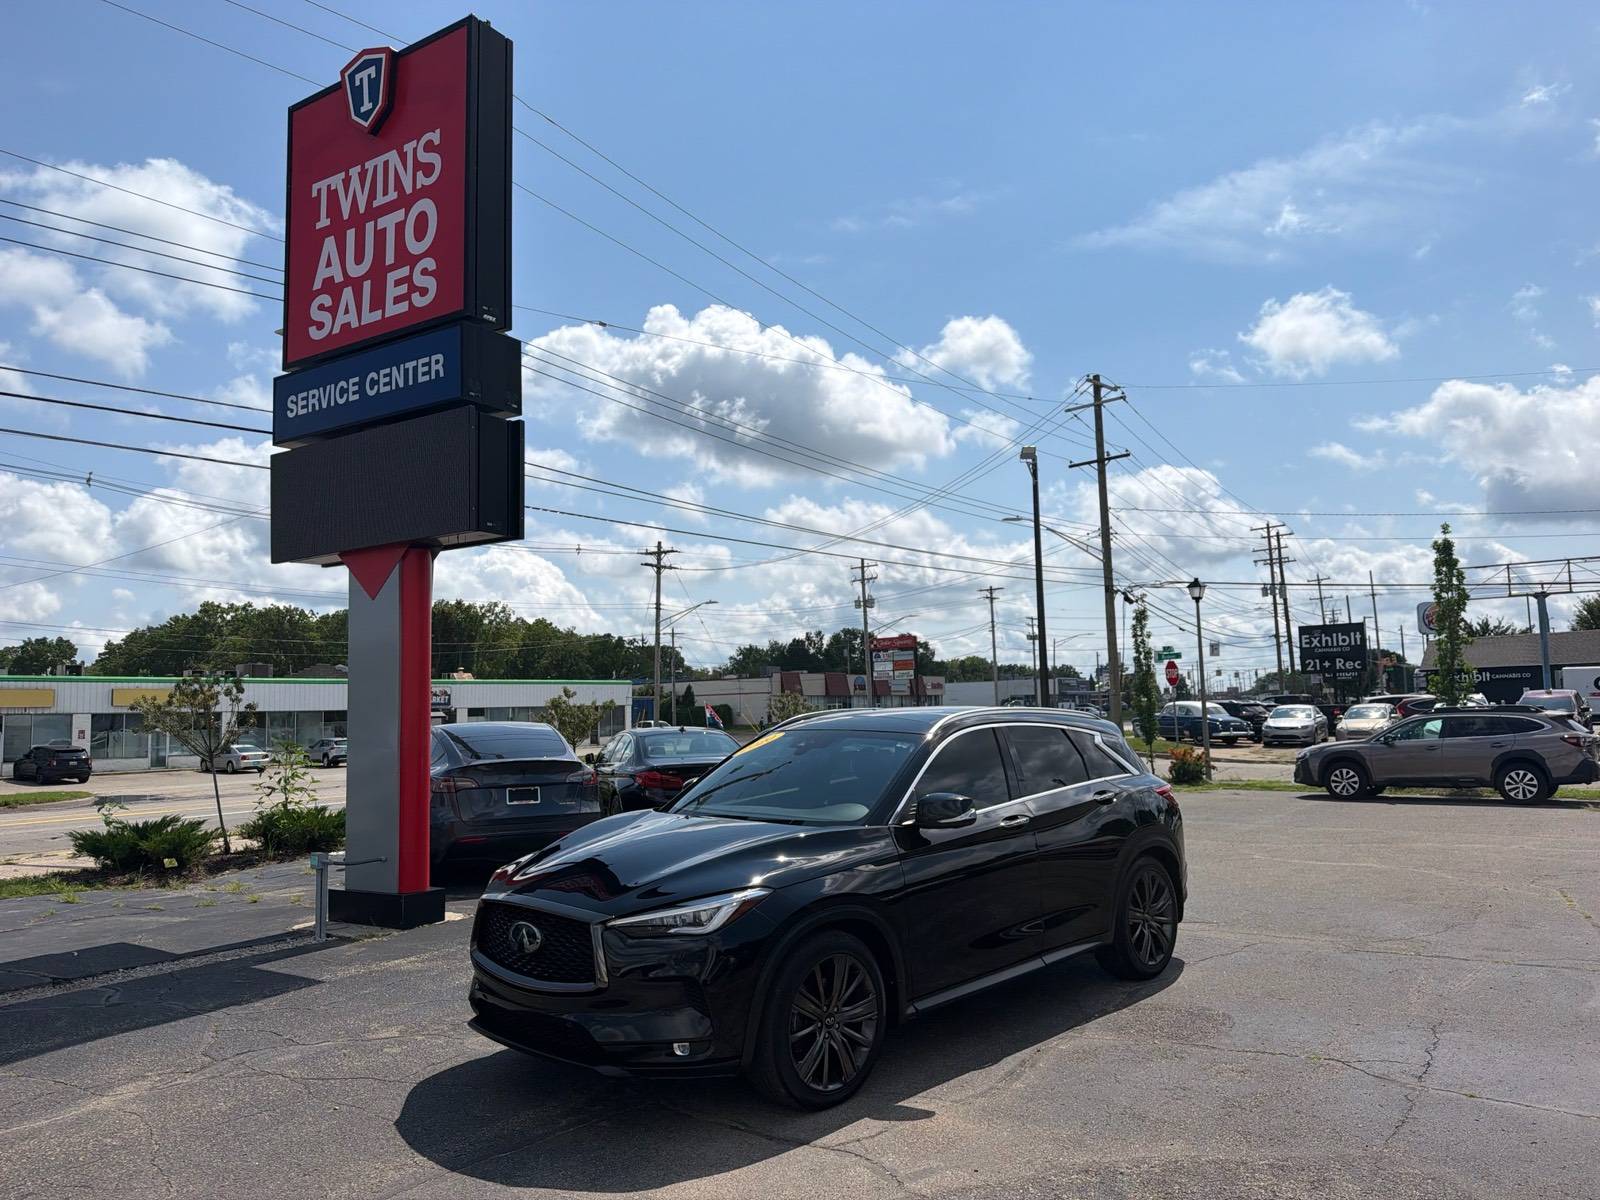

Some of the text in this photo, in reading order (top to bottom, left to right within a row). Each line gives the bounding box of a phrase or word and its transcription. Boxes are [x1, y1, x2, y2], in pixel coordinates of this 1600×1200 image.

[354, 65, 376, 113] T
[311, 128, 442, 230] TWINS
[312, 198, 438, 291] AUTO
[308, 257, 437, 341] SALES
[286, 353, 446, 418] SERVICE CENTER
[1166, 668, 1178, 678] STOP
[1305, 658, 1362, 671] 21+ Rec
